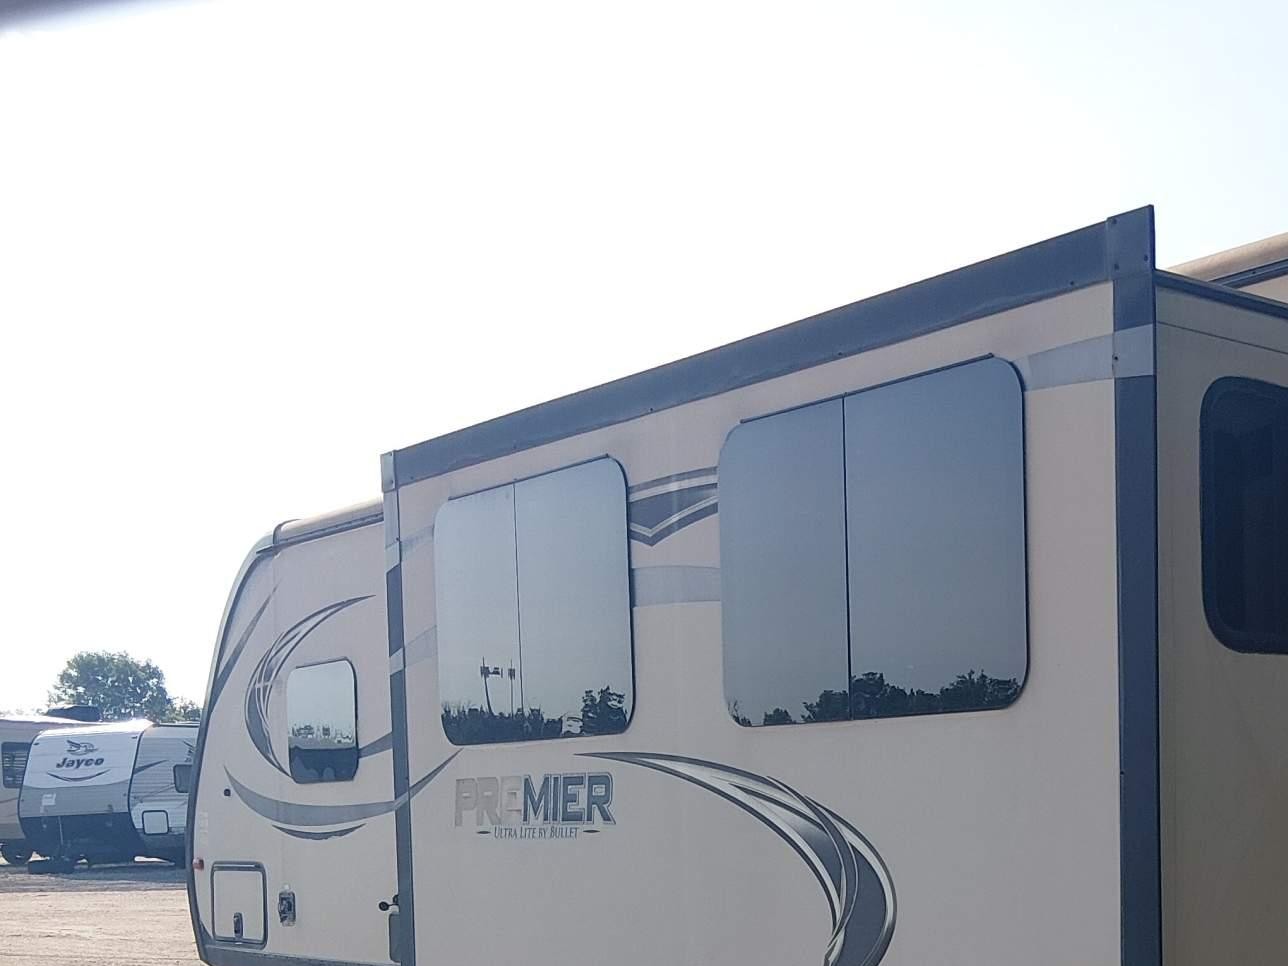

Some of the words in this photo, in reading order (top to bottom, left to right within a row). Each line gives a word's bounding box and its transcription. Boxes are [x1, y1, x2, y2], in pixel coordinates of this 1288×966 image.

[56, 757, 104, 769] Jayco
[455, 772, 616, 827] PREMIER
[550, 825, 579, 839] BULLET
